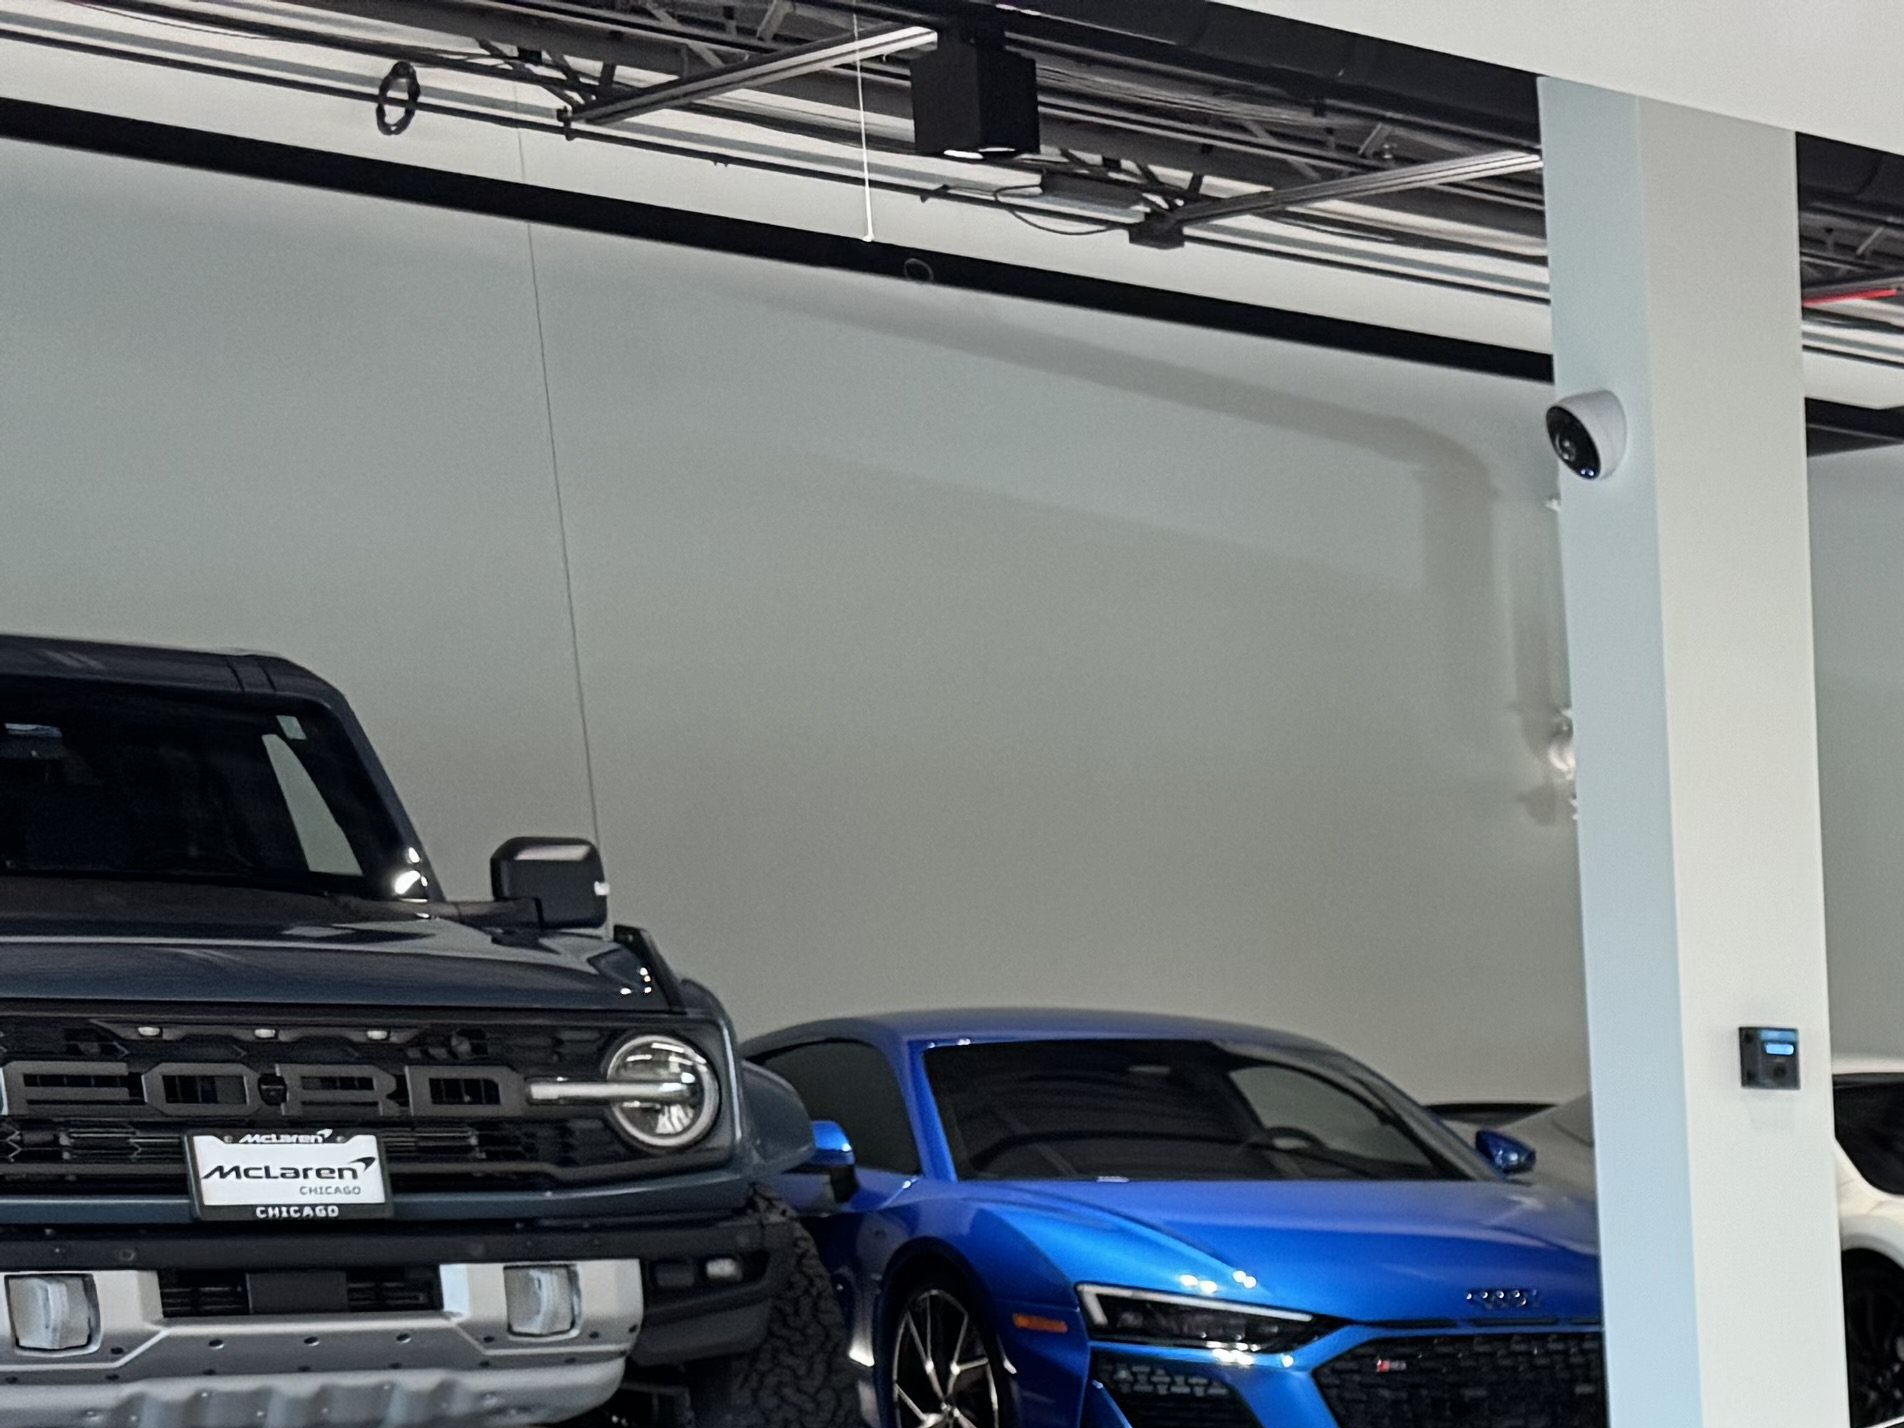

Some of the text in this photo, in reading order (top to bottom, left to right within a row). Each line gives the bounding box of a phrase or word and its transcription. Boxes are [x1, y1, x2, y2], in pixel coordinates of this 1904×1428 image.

[1, 1061, 525, 1118] FORD
[239, 1133, 324, 1144] McLaren
[202, 1164, 358, 1180] McLaren
[299, 1185, 362, 1196] CHICAGO
[255, 1205, 340, 1218] CHICAGO
